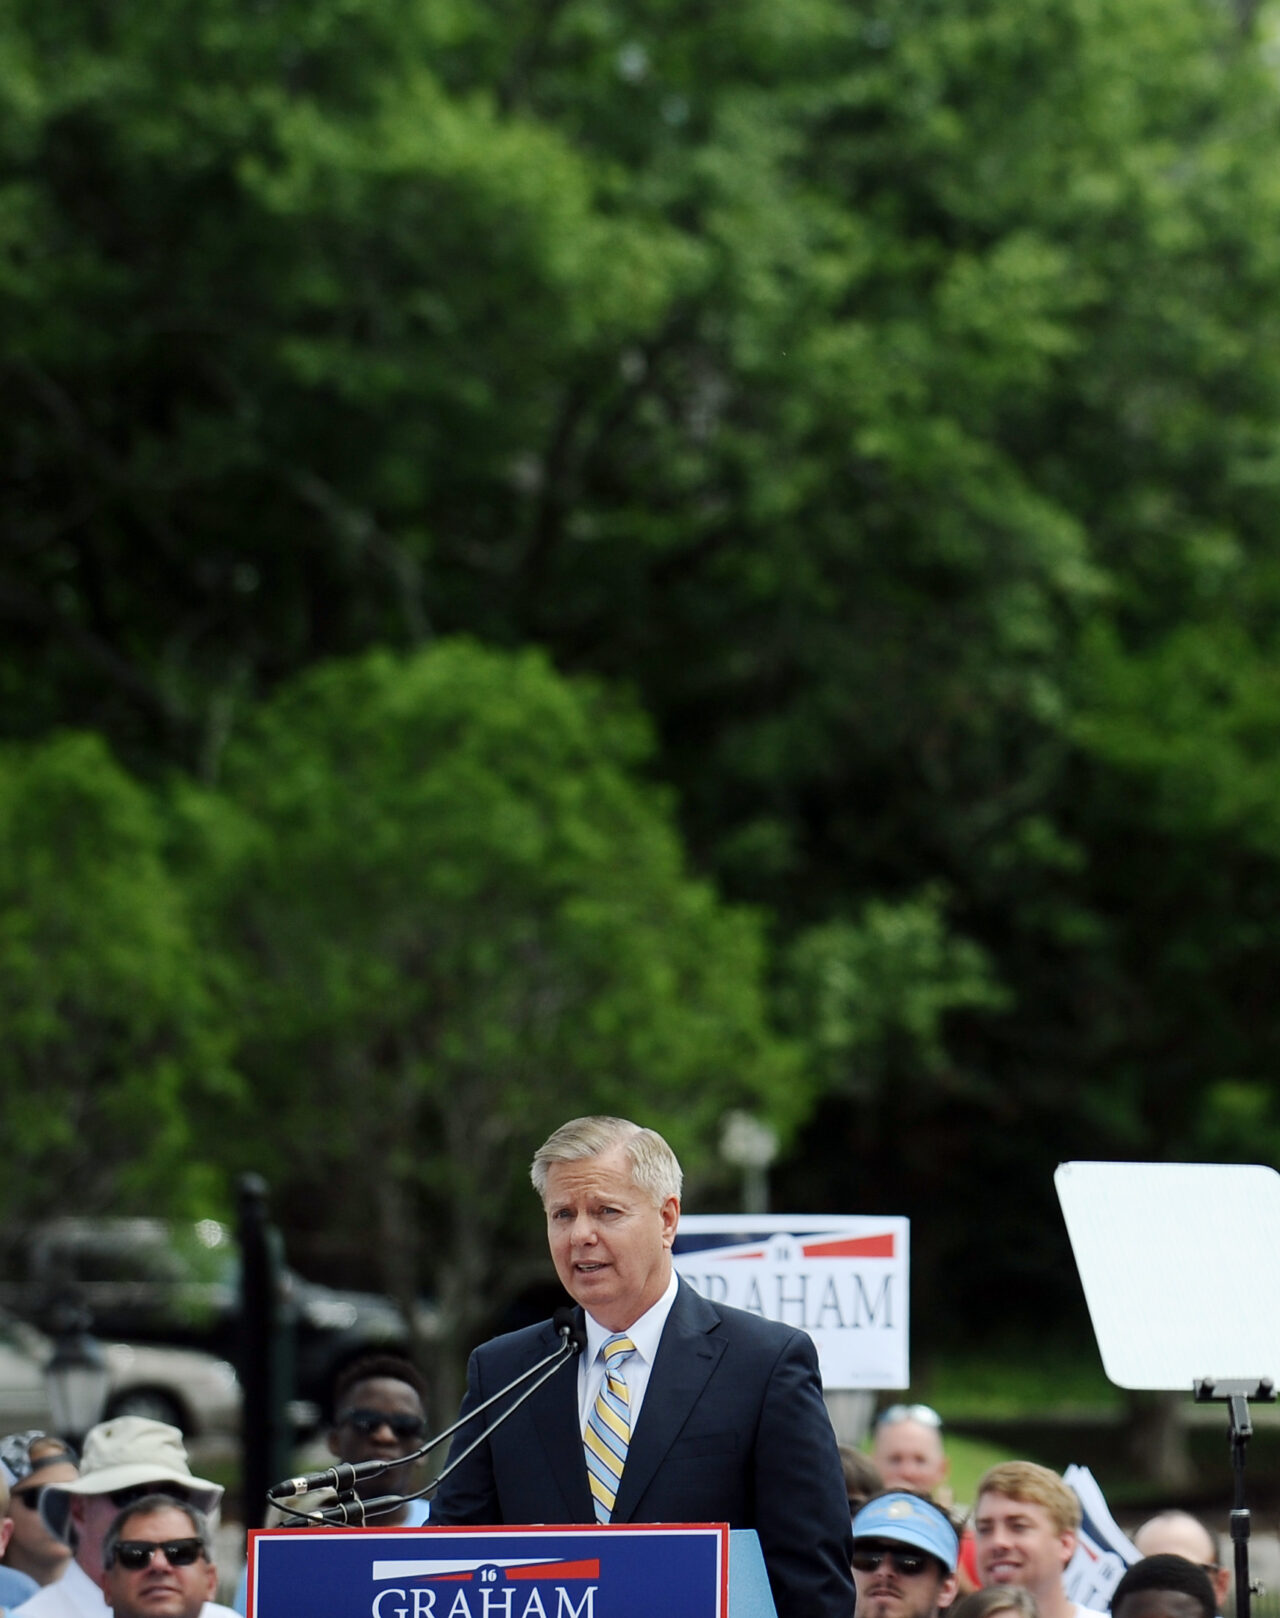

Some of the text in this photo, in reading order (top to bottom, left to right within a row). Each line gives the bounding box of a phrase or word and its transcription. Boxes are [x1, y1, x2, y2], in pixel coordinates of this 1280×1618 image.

[681, 1272, 896, 1328] RAHAM
[481, 1569, 497, 1582] 16
[371, 1586, 598, 1618] GRAHAM
